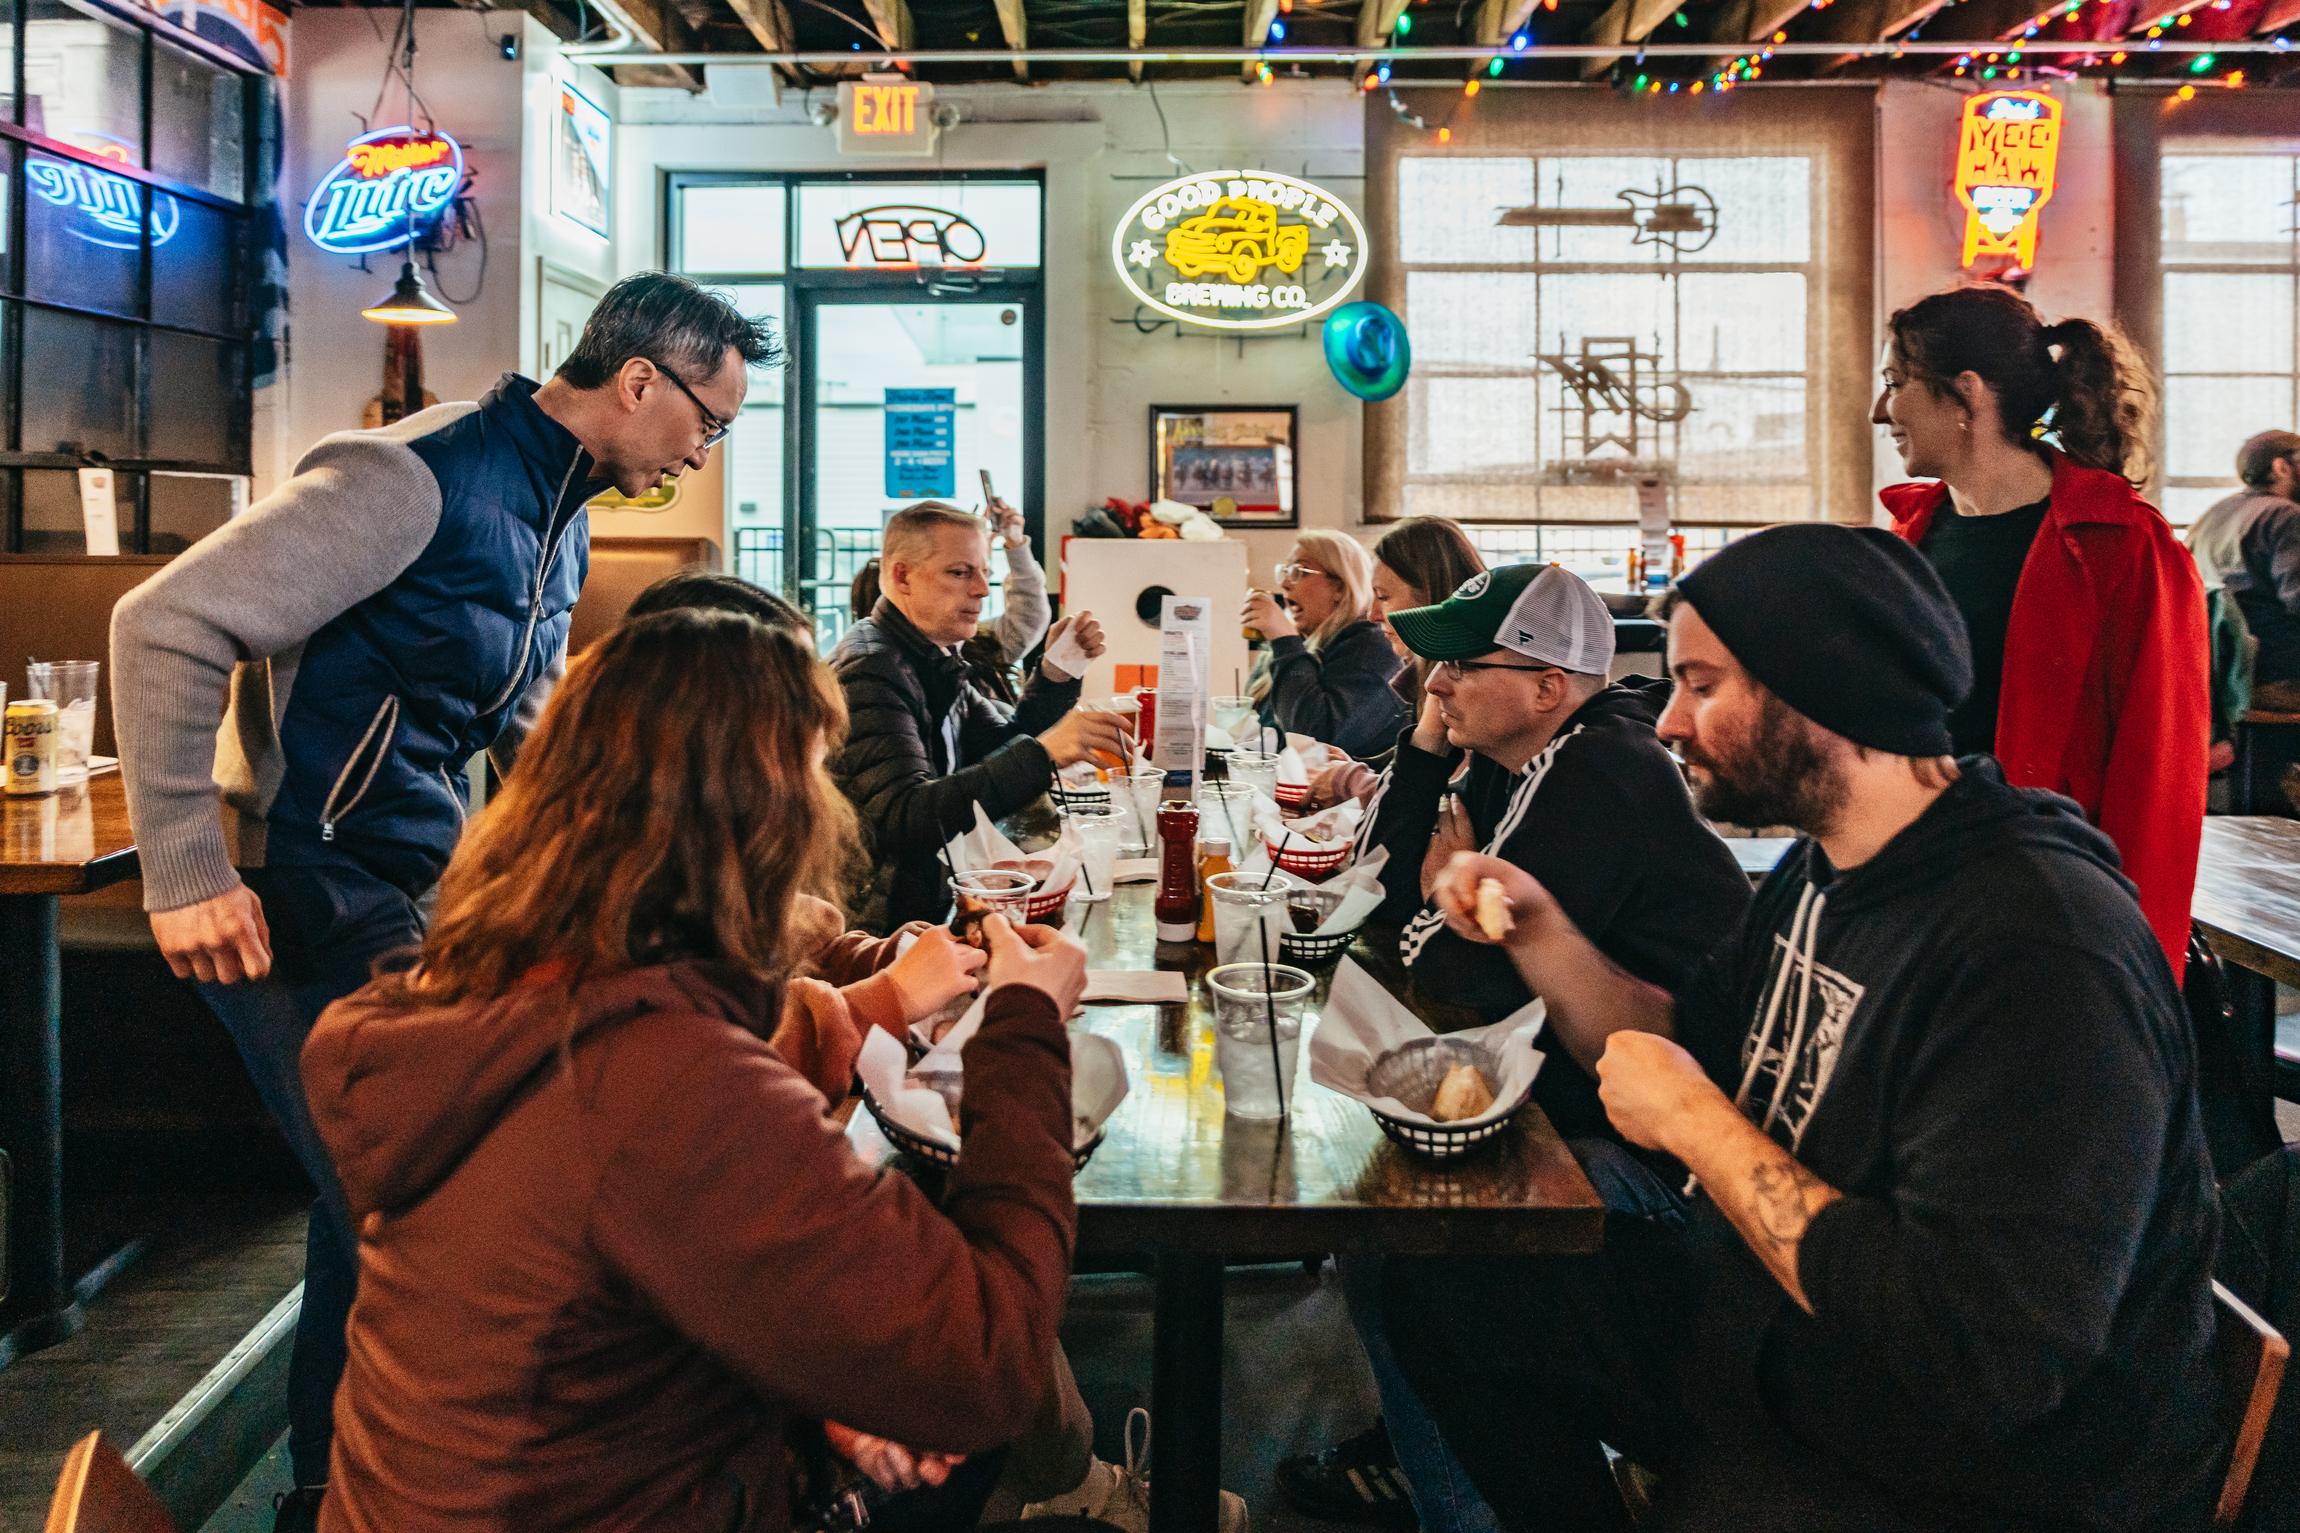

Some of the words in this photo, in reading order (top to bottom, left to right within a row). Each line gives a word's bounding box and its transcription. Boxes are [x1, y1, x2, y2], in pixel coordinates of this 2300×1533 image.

[853, 85, 920, 134] EXIT
[347, 141, 450, 178] Miller
[315, 166, 457, 240] Lite
[1141, 180, 1222, 230] GOOD
[1227, 179, 1339, 229] PEOPLE
[1165, 282, 1270, 307] BREWING
[6, 716, 52, 736] Coors
